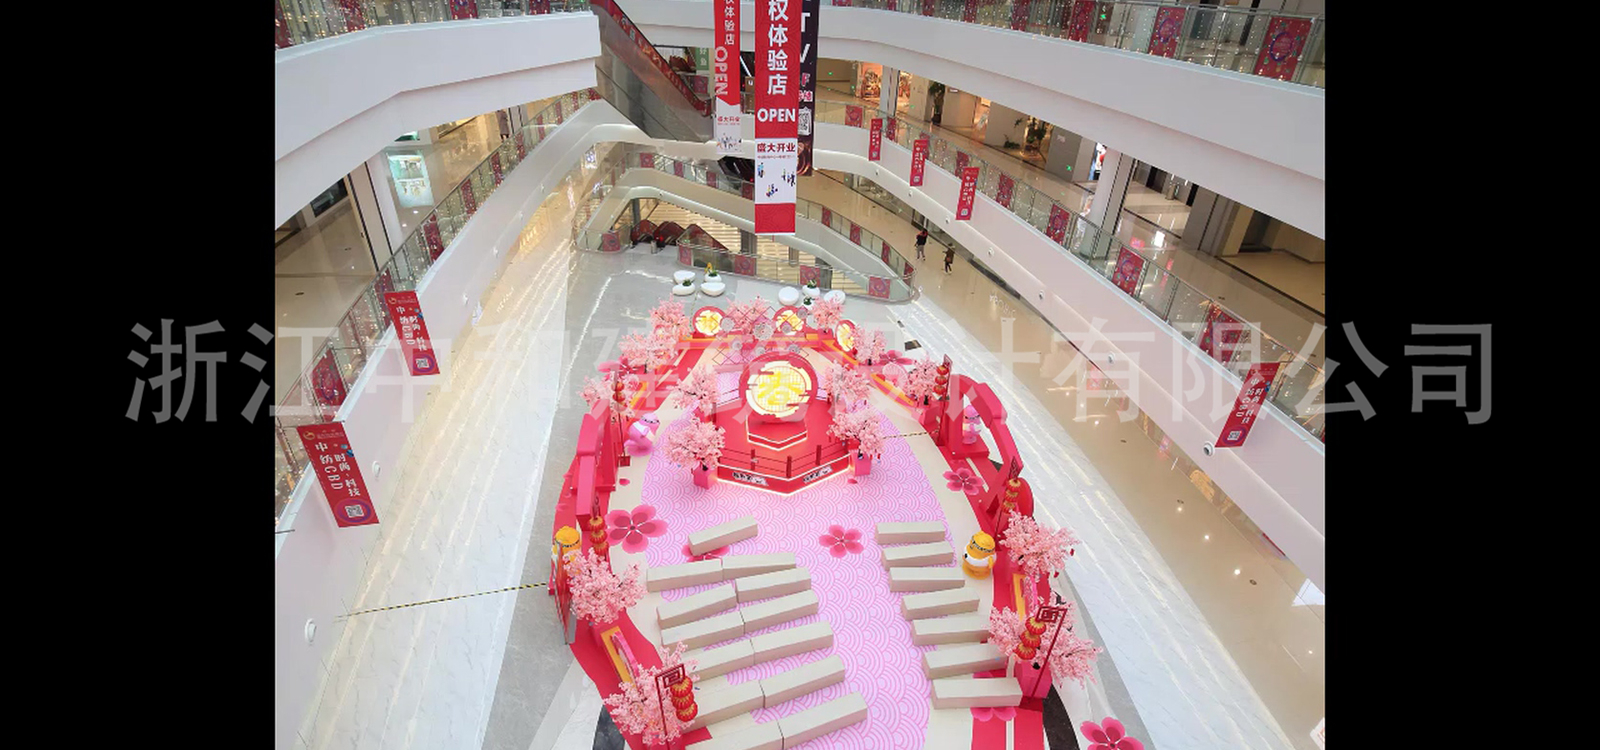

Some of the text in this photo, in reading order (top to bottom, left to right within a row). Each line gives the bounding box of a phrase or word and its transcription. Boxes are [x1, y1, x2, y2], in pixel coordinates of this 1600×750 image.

[767, 0, 788, 96] 权体验店
[714, 46, 728, 96] OPEN
[757, 108, 796, 123] OPEN
[757, 142, 796, 152] 盛大开业
